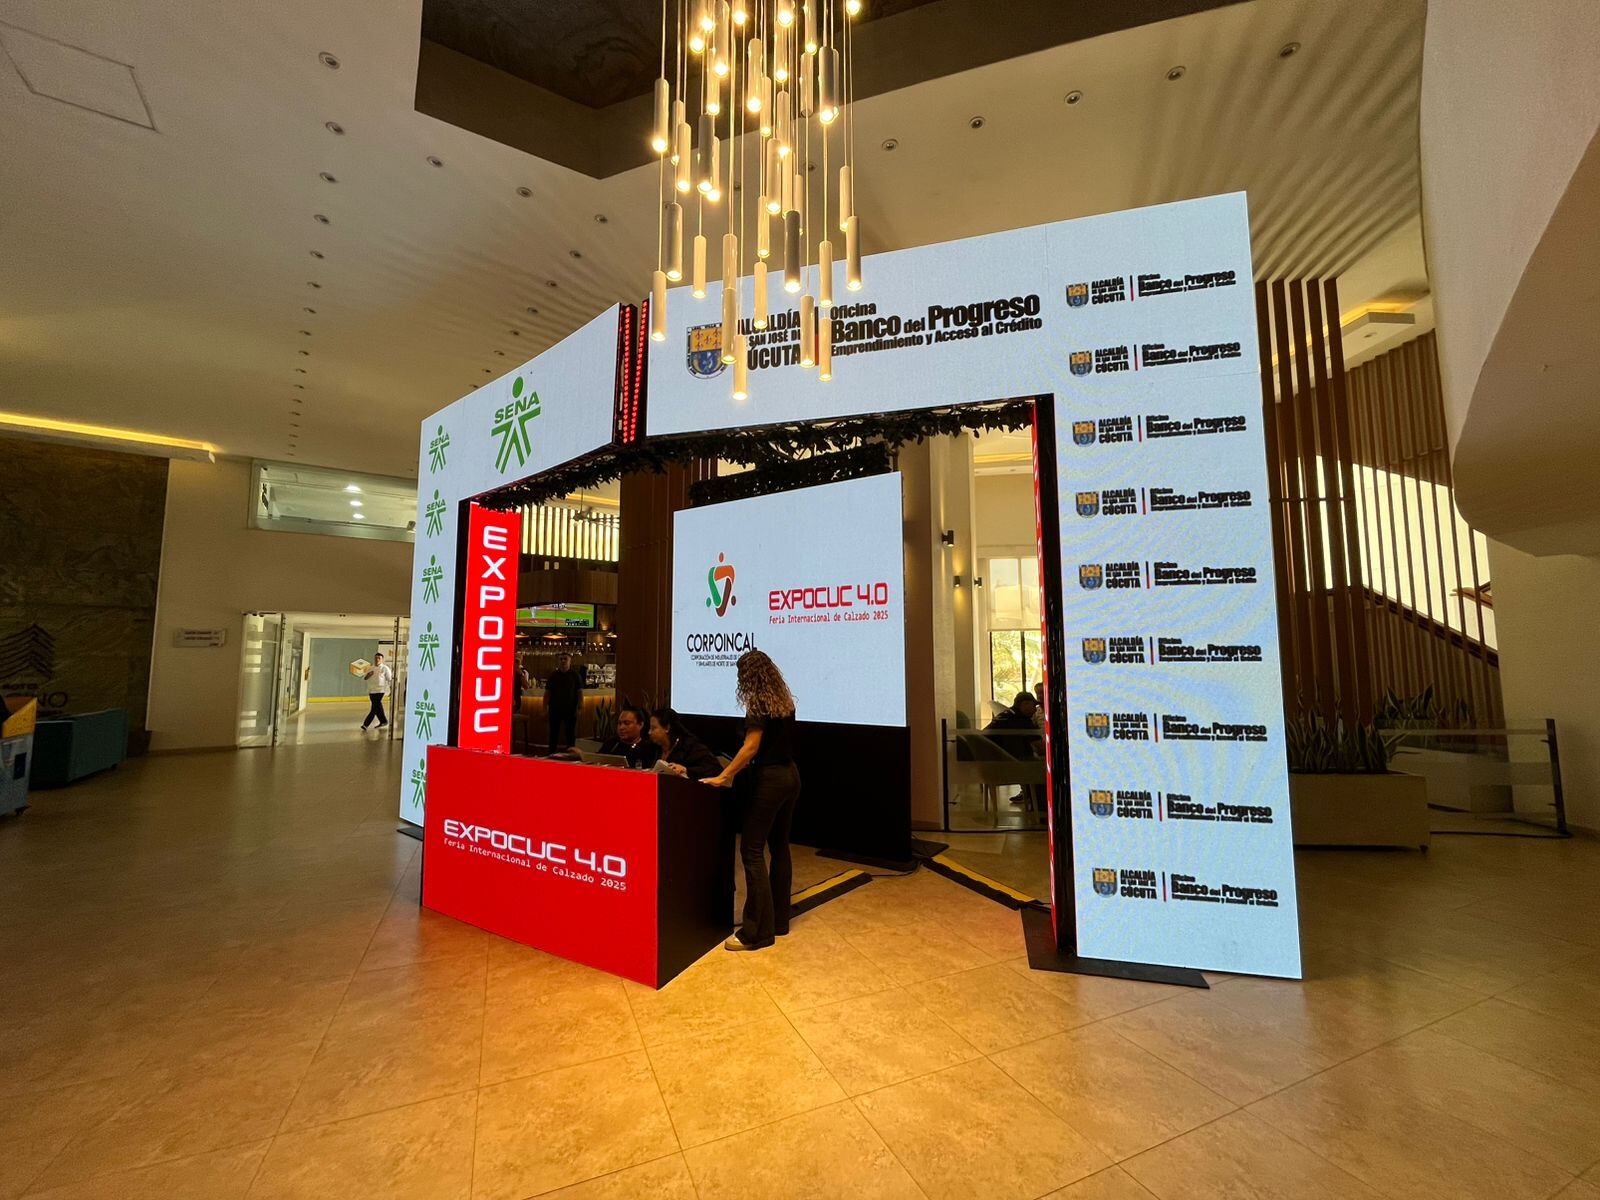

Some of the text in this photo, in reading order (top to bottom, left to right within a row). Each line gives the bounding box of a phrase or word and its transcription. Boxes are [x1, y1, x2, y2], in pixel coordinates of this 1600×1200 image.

[1138, 278, 1172, 291] Banco
[1184, 271, 1235, 287] Progreso
[831, 303, 876, 320] Oficina
[831, 294, 1040, 344] Banco del Progreso
[749, 334, 766, 347] SAN
[767, 328, 788, 344] JOSÉ
[831, 317, 1042, 357] Emprendimiento y Acceso al Crédito
[747, 343, 801, 371] ÚCUTA
[1143, 349, 1176, 361] Banco
[1189, 342, 1240, 358] Progreso
[494, 392, 540, 424] SENA
[1146, 420, 1181, 433] Banco
[1194, 415, 1245, 431] Progreso
[430, 433, 449, 449] SENA
[427, 499, 446, 512] SENA
[1150, 494, 1185, 505] Banco
[1198, 490, 1250, 503] Progreso
[423, 566, 442, 576] SENA
[1155, 568, 1189, 579] Banco
[1203, 566, 1256, 580] Progreso
[769, 582, 888, 610] EXPOCUC 4.0
[769, 610, 888, 624] Feria Internacional de Calzado 2025
[473, 525, 508, 733] EXPOCUC
[419, 634, 439, 643] SENA
[687, 632, 757, 652] CORPOINCAL
[1159, 644, 1194, 656] Banco
[1207, 644, 1261, 657] Progreso
[416, 701, 435, 711] SENA
[1163, 722, 1199, 734] Banco
[1212, 722, 1267, 736] Progreso
[412, 769, 426, 779] SEN
[1167, 801, 1203, 813] Banco
[1217, 802, 1272, 817] Progreso
[444, 819, 626, 877] EXPOCUC 4.0
[469, 845, 531, 867] Internacional
[536, 863, 547, 871] de
[553, 866, 594, 883] Calzado
[601, 878, 626, 891] 2025
[1172, 881, 1208, 894] Banco
[1222, 884, 1277, 900] Progreso
